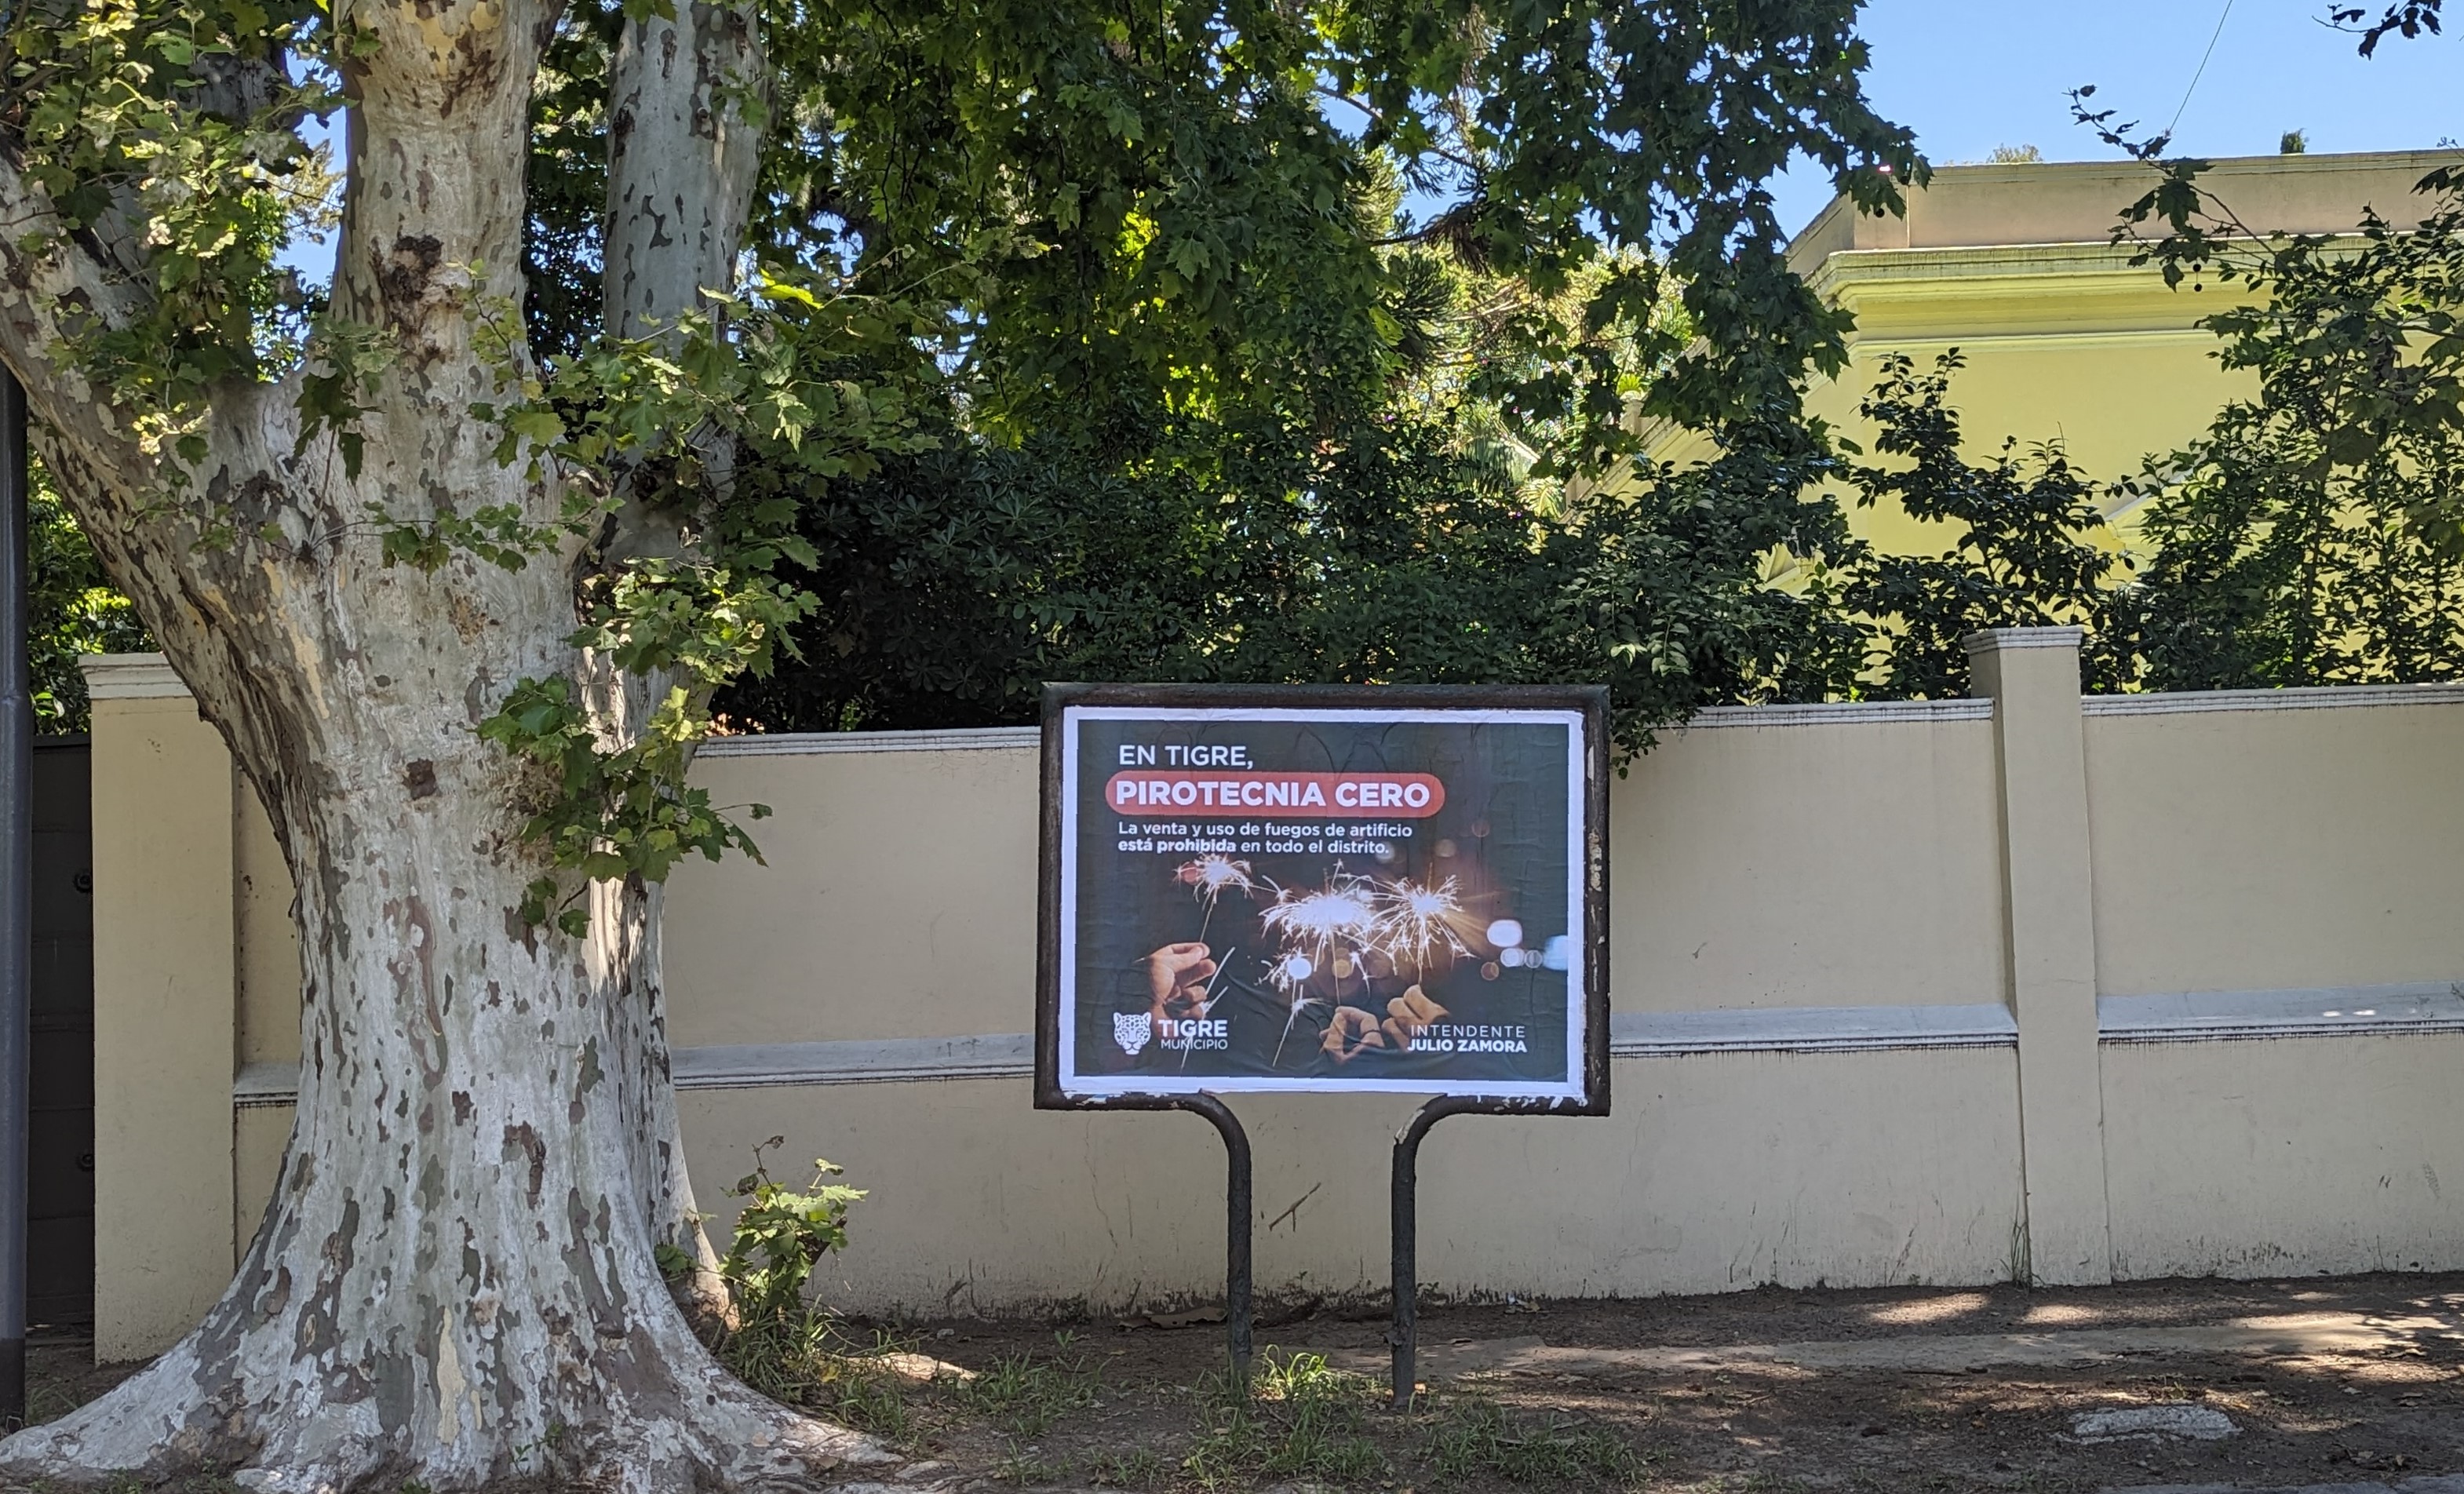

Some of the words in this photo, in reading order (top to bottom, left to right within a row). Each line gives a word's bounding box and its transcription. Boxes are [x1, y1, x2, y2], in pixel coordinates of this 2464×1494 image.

[1119, 745, 1156, 765] EN
[1165, 745, 1253, 770] TIGRE,
[1117, 781, 1326, 806] PIROTECNIA
[1335, 782, 1430, 807] CERO
[1118, 822, 1138, 835] La
[1143, 822, 1187, 836] venta
[1192, 825, 1201, 837] y
[1206, 825, 1235, 836] uso
[1239, 822, 1260, 836] de
[1265, 822, 1320, 839] fuegos
[1325, 822, 1346, 837] de
[1349, 823, 1412, 837] artificio
[1117, 837, 1153, 851] está
[1157, 838, 1237, 854] prohibida
[1241, 843, 1260, 853] en
[1266, 840, 1304, 853] todo
[1308, 839, 1323, 853] el
[1327, 840, 1390, 854] distrito.
[1157, 1019, 1228, 1037] TIGRE
[1410, 1024, 1525, 1038] INTENDENTE
[1161, 1039, 1228, 1050] MUNICIPIO
[1407, 1038, 1454, 1051] JULIO
[1457, 1039, 1528, 1053] ZAMORA
